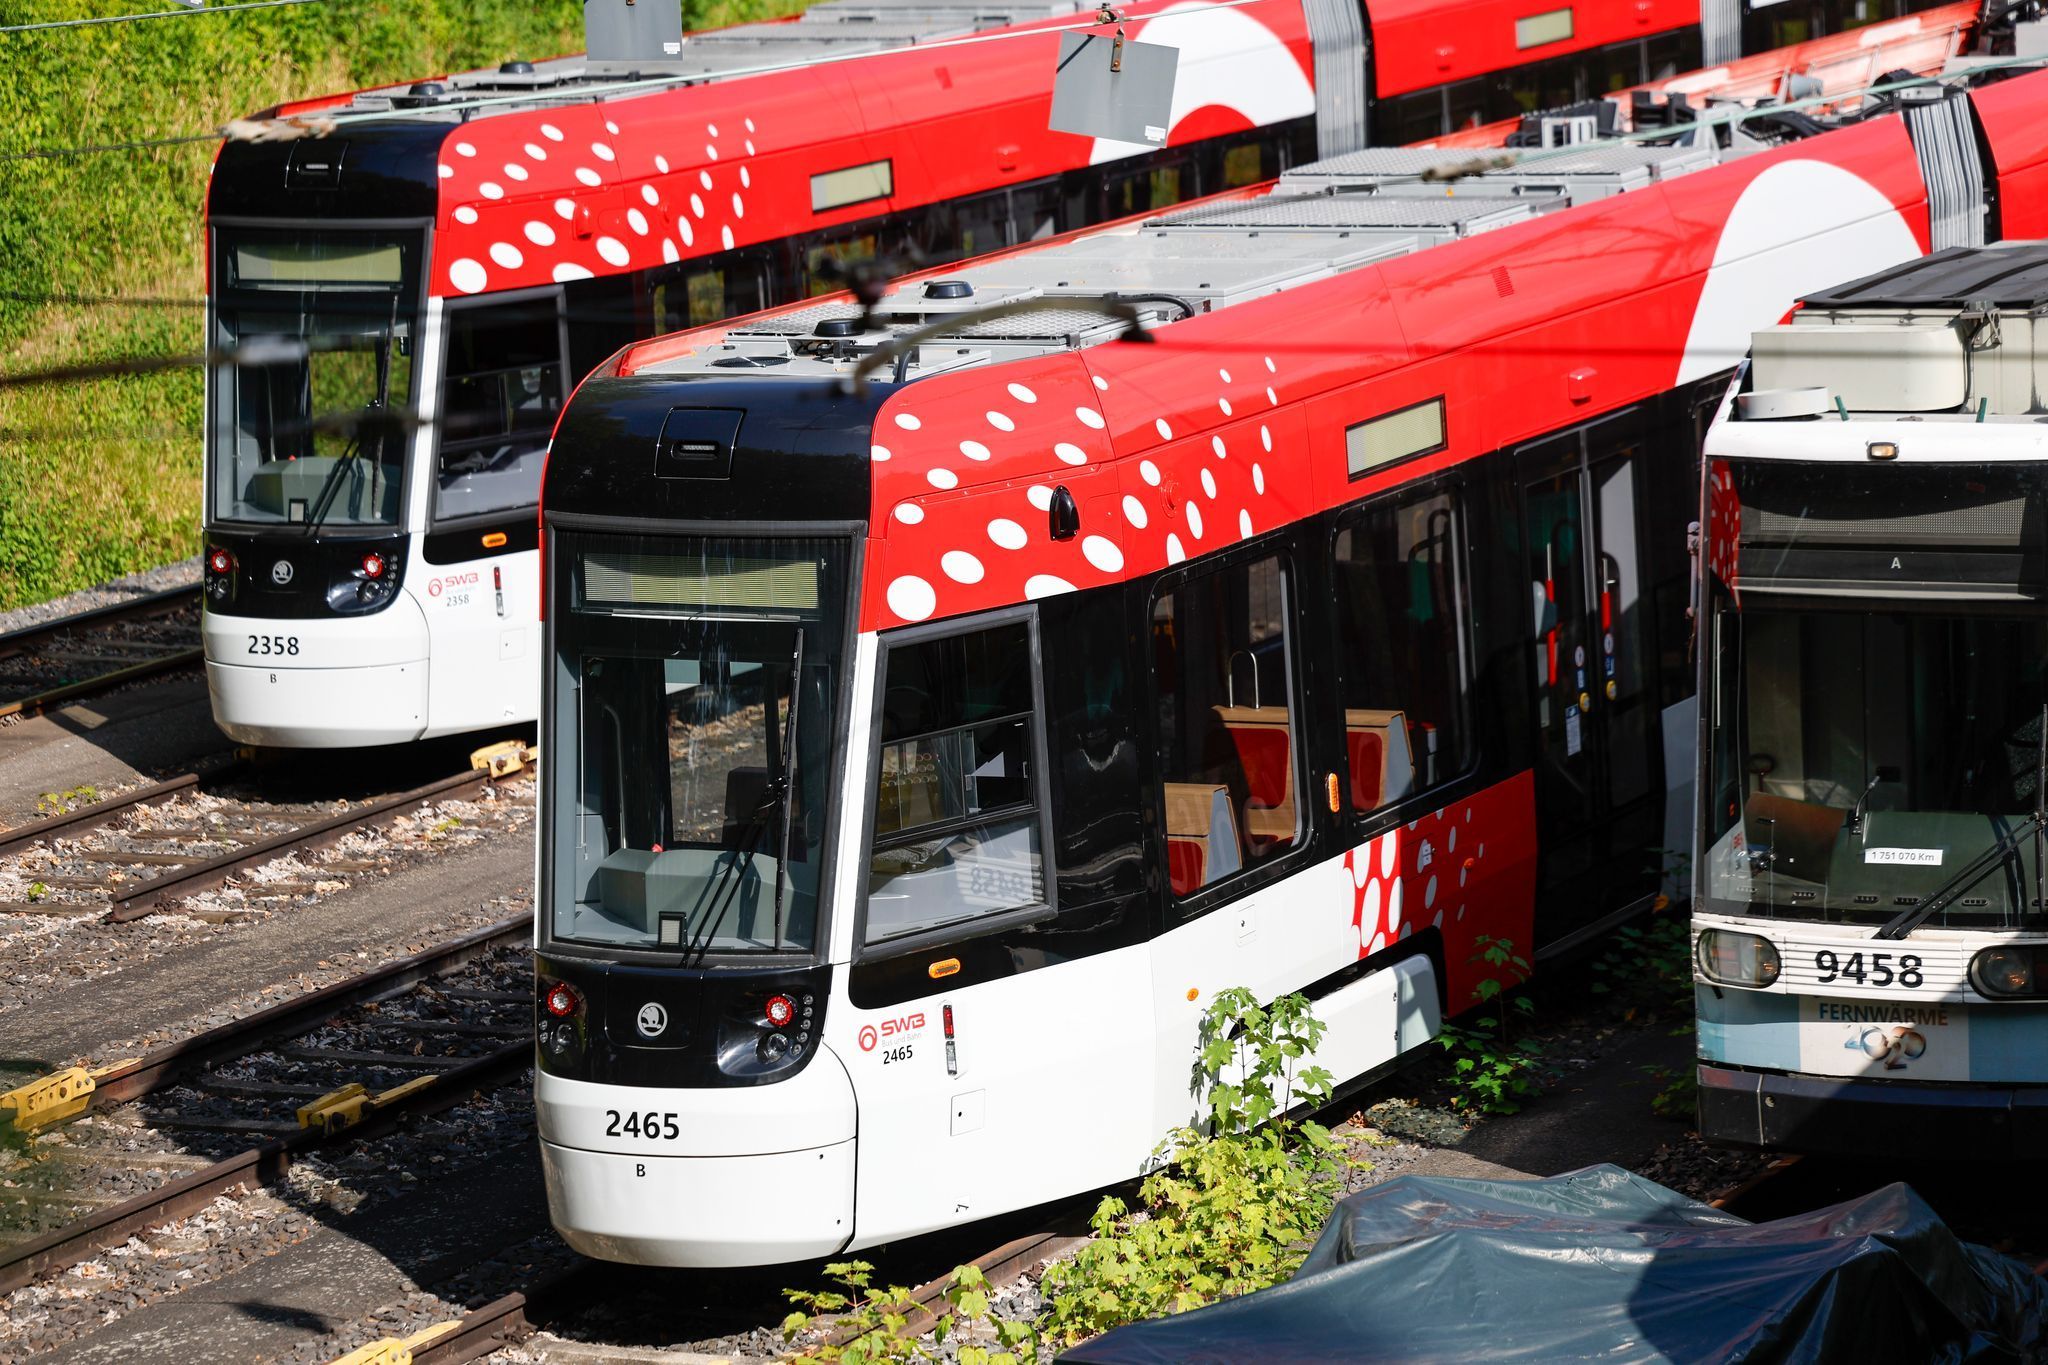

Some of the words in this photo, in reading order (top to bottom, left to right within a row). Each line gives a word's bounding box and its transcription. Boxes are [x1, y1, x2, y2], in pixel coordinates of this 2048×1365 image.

[1890, 556, 1901, 569] A
[445, 572, 479, 588] SWB
[446, 593, 470, 607] 2358
[247, 634, 300, 656] 2358
[269, 673, 277, 684] B
[1871, 851, 1877, 860] 1
[1879, 851, 1895, 861] 751
[1898, 852, 1917, 861] 070
[1918, 853, 1935, 862] Km
[1814, 949, 1924, 989] 9458
[1818, 1003, 1950, 1027] FERNWÄRME
[881, 1012, 926, 1037] SWB
[882, 1044, 914, 1065] 2465
[605, 1109, 680, 1140] 2465
[635, 1163, 646, 1178] B
